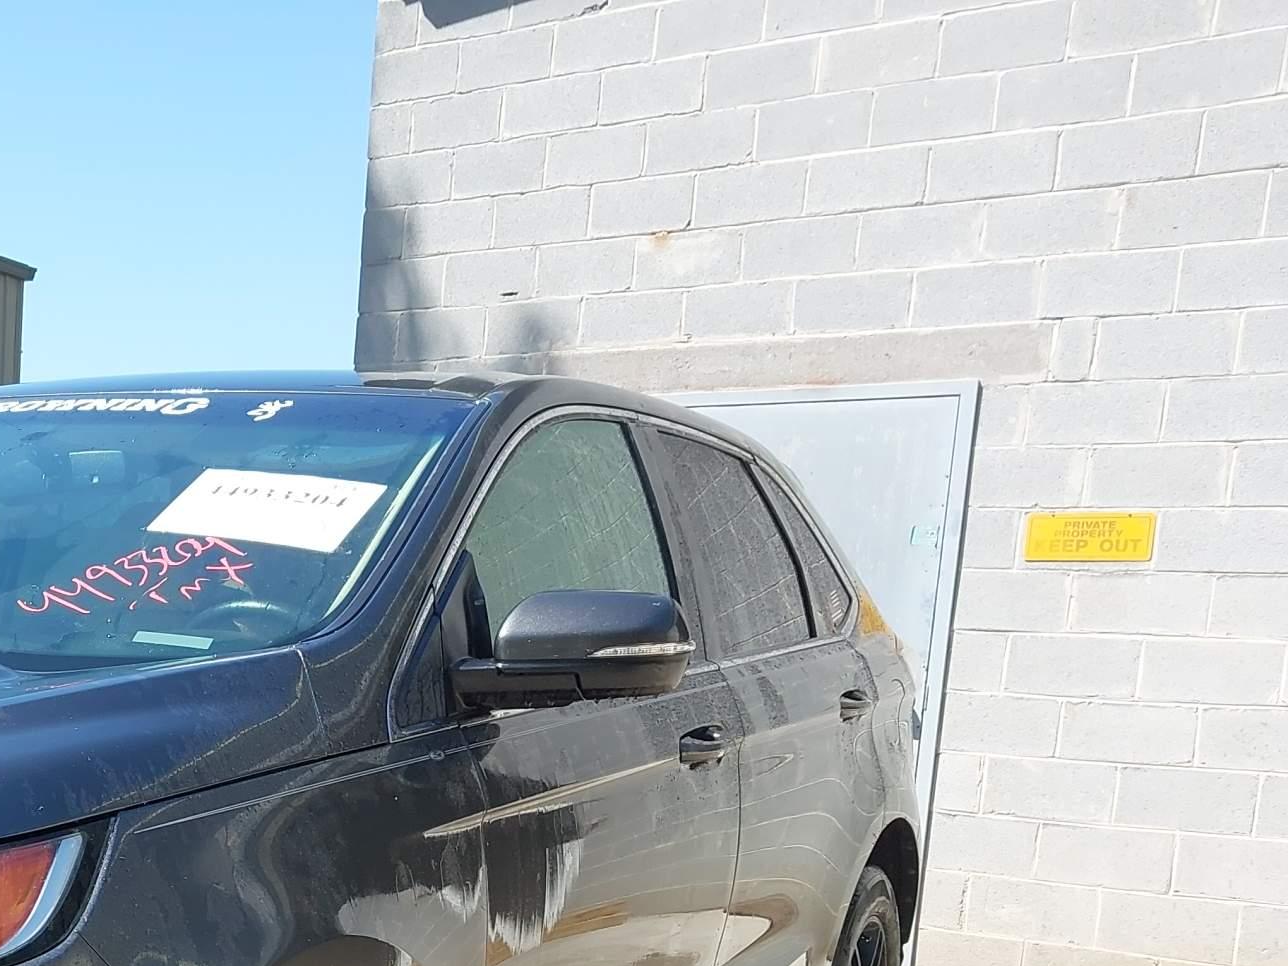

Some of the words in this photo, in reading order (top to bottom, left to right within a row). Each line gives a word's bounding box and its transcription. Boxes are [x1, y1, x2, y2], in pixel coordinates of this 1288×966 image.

[1063, 520, 1118, 530] PRIVATE
[1053, 529, 1124, 538] PROPERTY
[1034, 539, 1089, 553] KEEP
[1099, 538, 1143, 553] OUT
